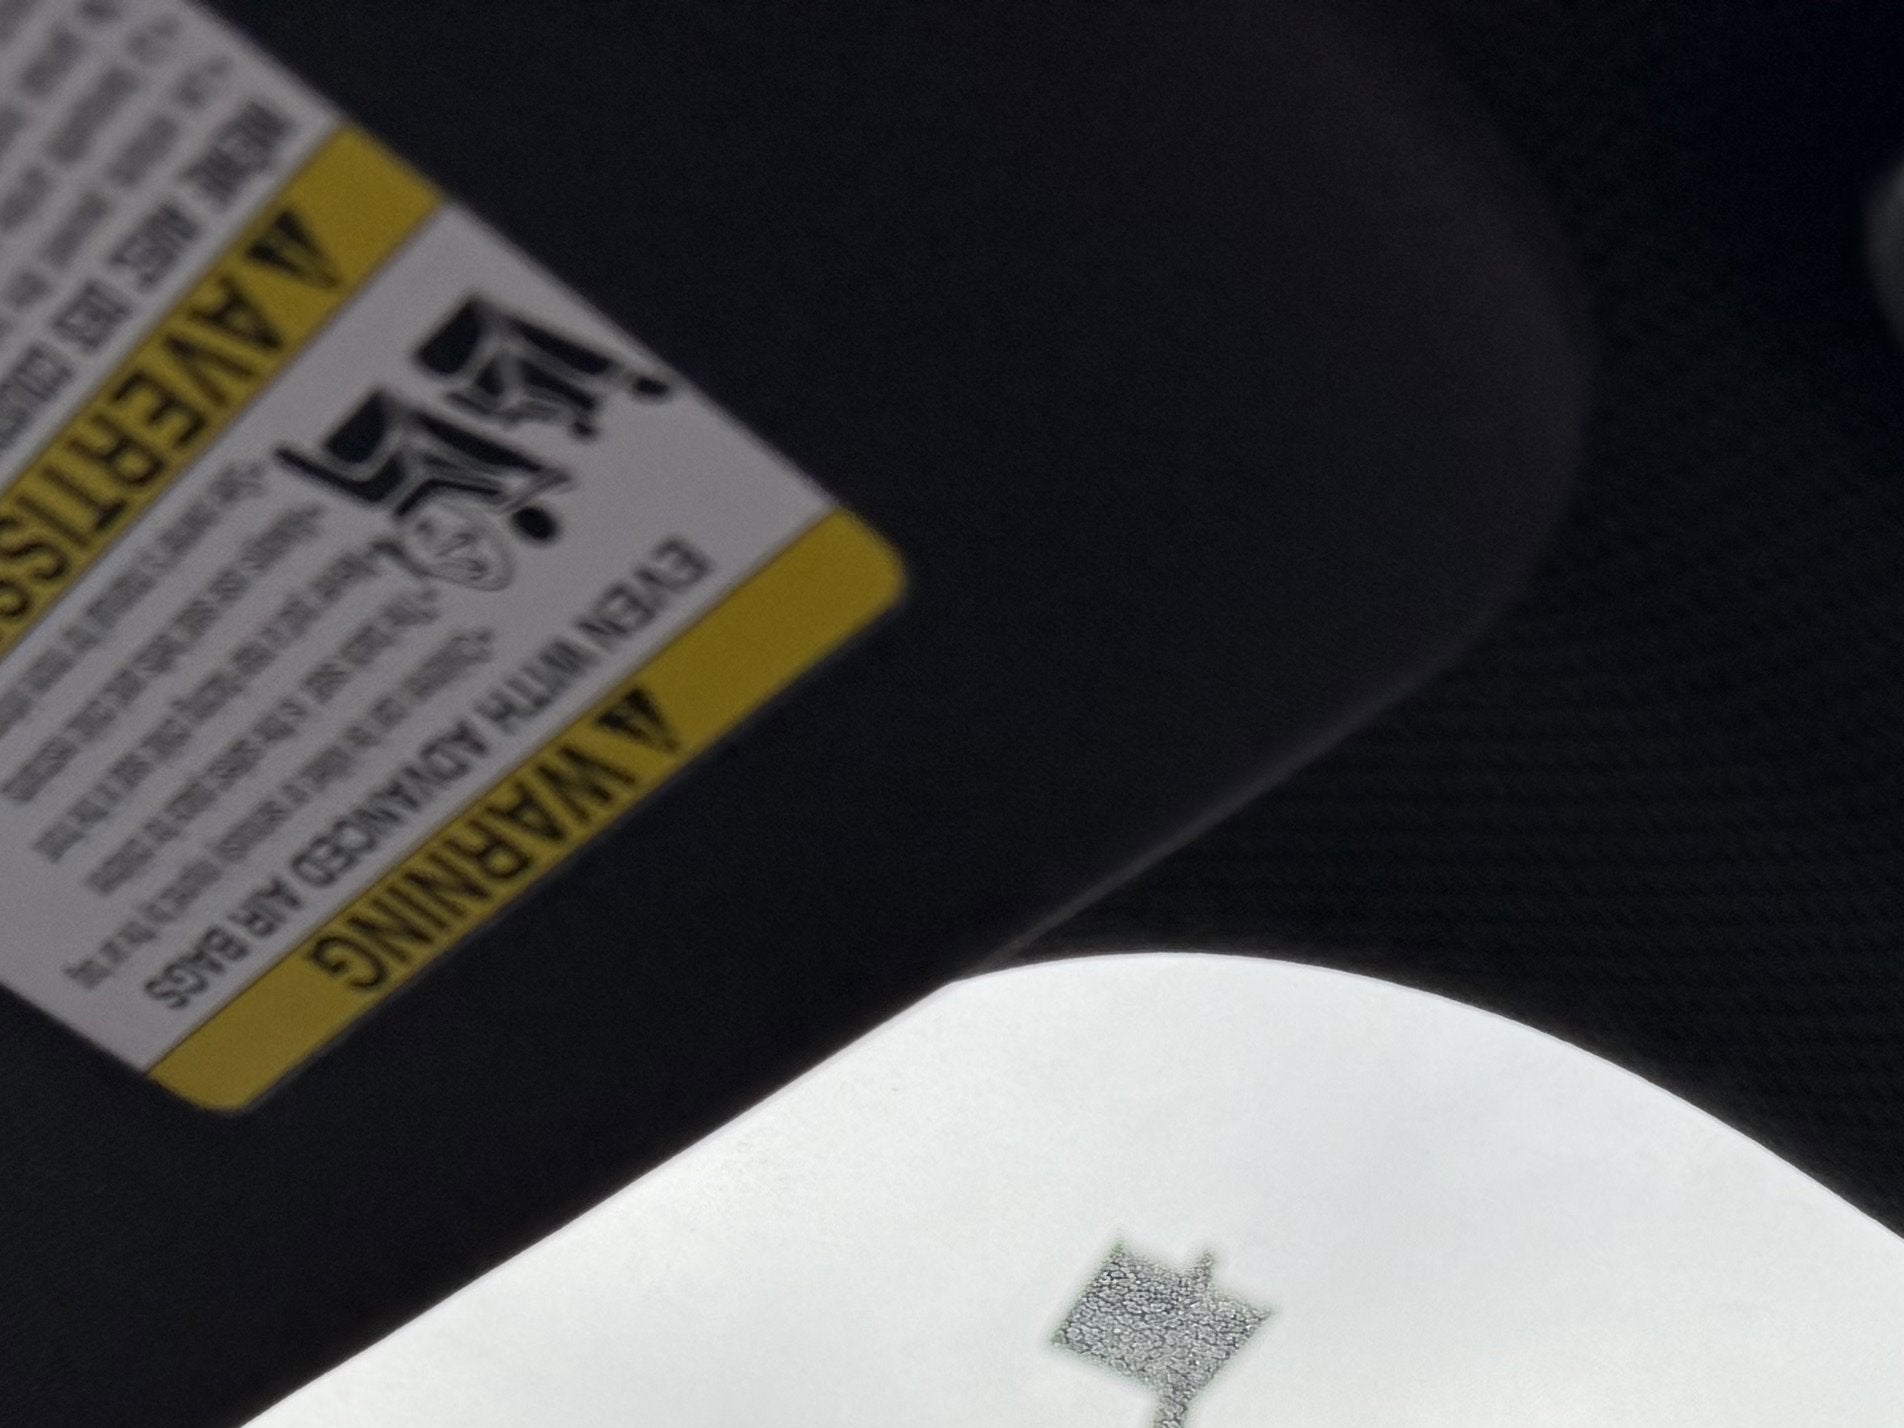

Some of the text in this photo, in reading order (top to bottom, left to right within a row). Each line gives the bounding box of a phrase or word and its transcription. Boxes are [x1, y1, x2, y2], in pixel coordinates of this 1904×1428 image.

[136, 532, 720, 1015] EVEN WITH ADVANCED AIR BAGS
[297, 733, 641, 997] WARNING
